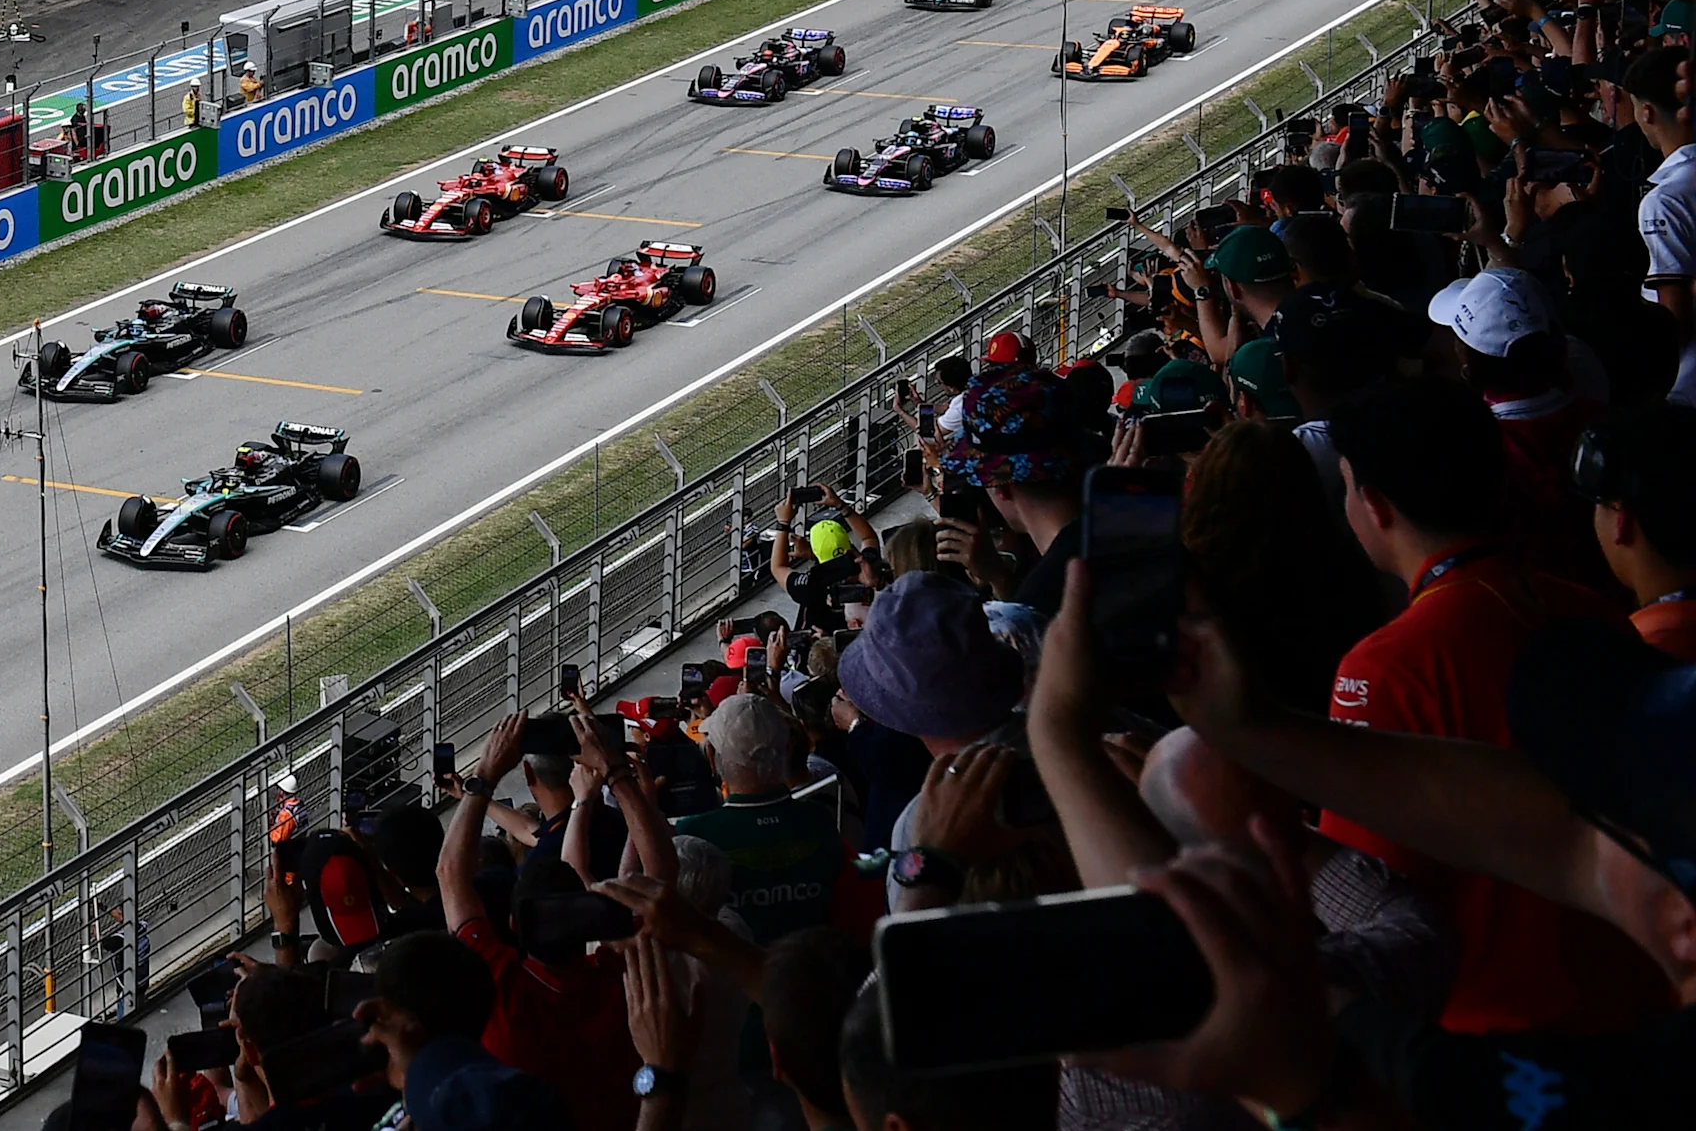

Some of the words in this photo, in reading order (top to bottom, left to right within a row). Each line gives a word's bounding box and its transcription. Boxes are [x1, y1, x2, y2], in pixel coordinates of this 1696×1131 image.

[392, 32, 497, 100] aramco
[236, 83, 357, 158] aramco
[61, 141, 197, 224] aramco
[1336, 676, 1370, 697] aws
